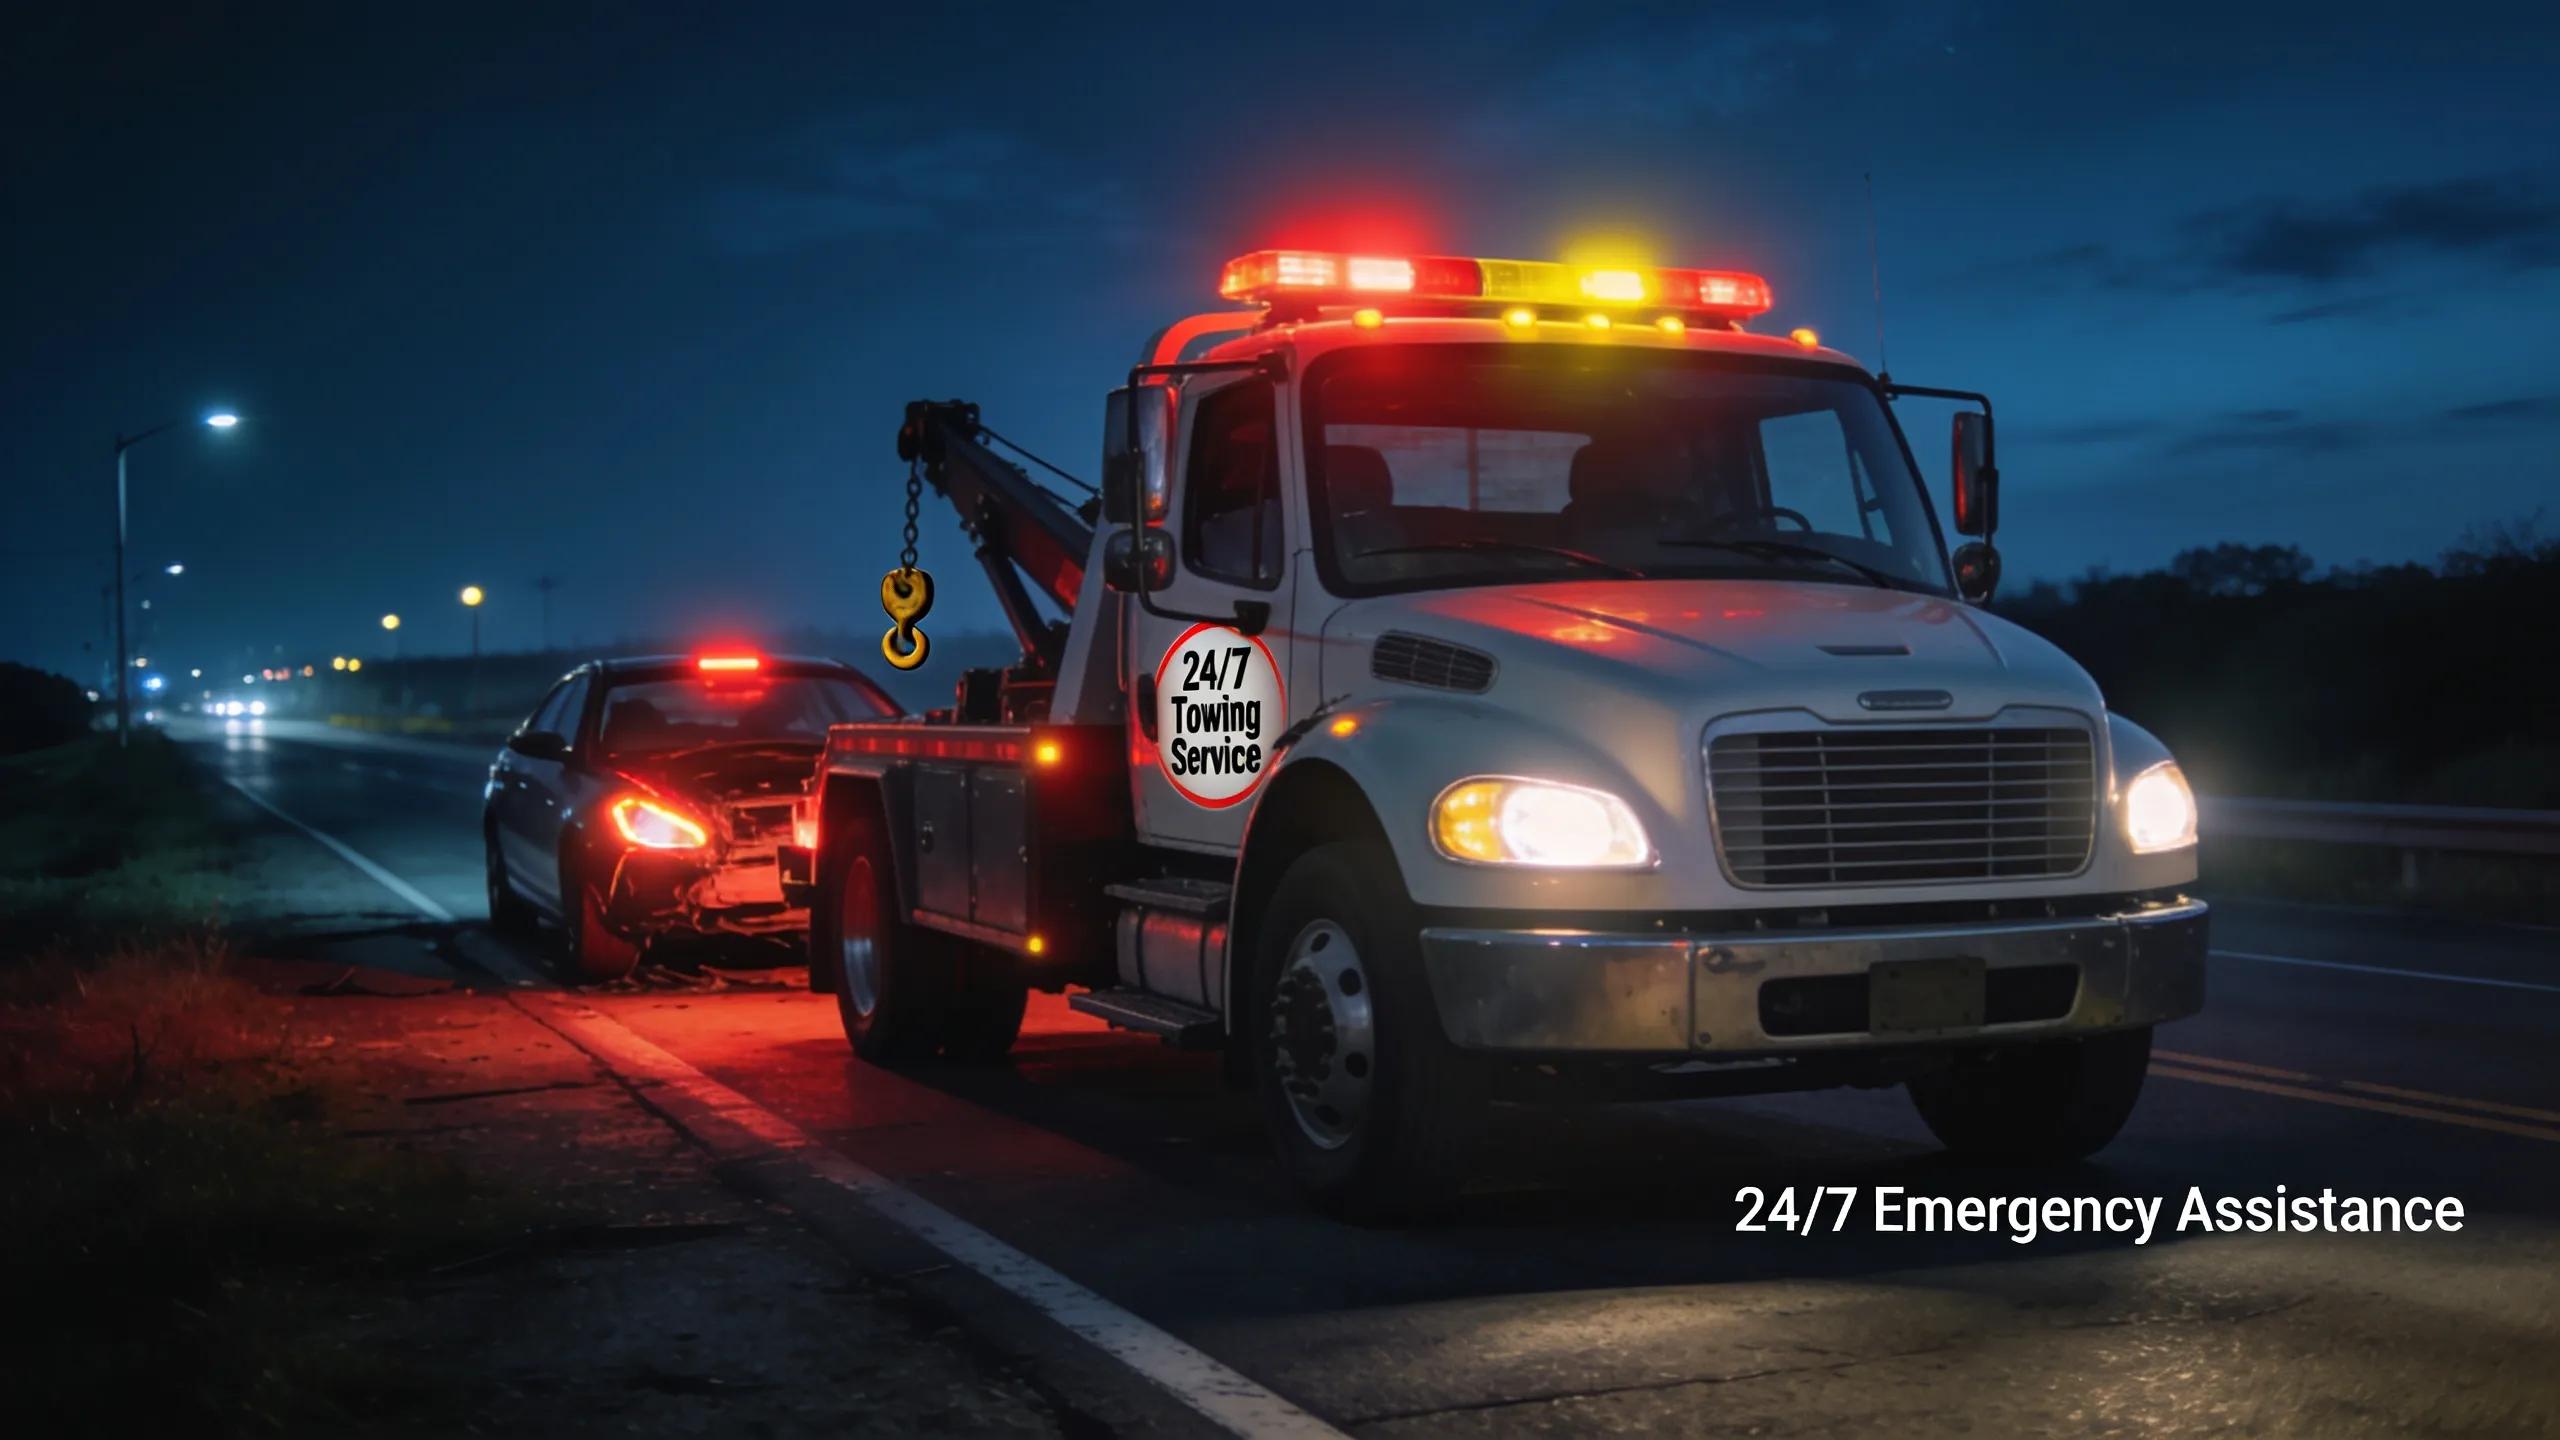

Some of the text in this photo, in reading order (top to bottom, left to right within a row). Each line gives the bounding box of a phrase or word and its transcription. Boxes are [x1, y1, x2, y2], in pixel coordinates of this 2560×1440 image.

[1183, 647, 1251, 691] 24/7
[1171, 694, 1261, 740] Towing
[1171, 736, 1262, 776] Service
